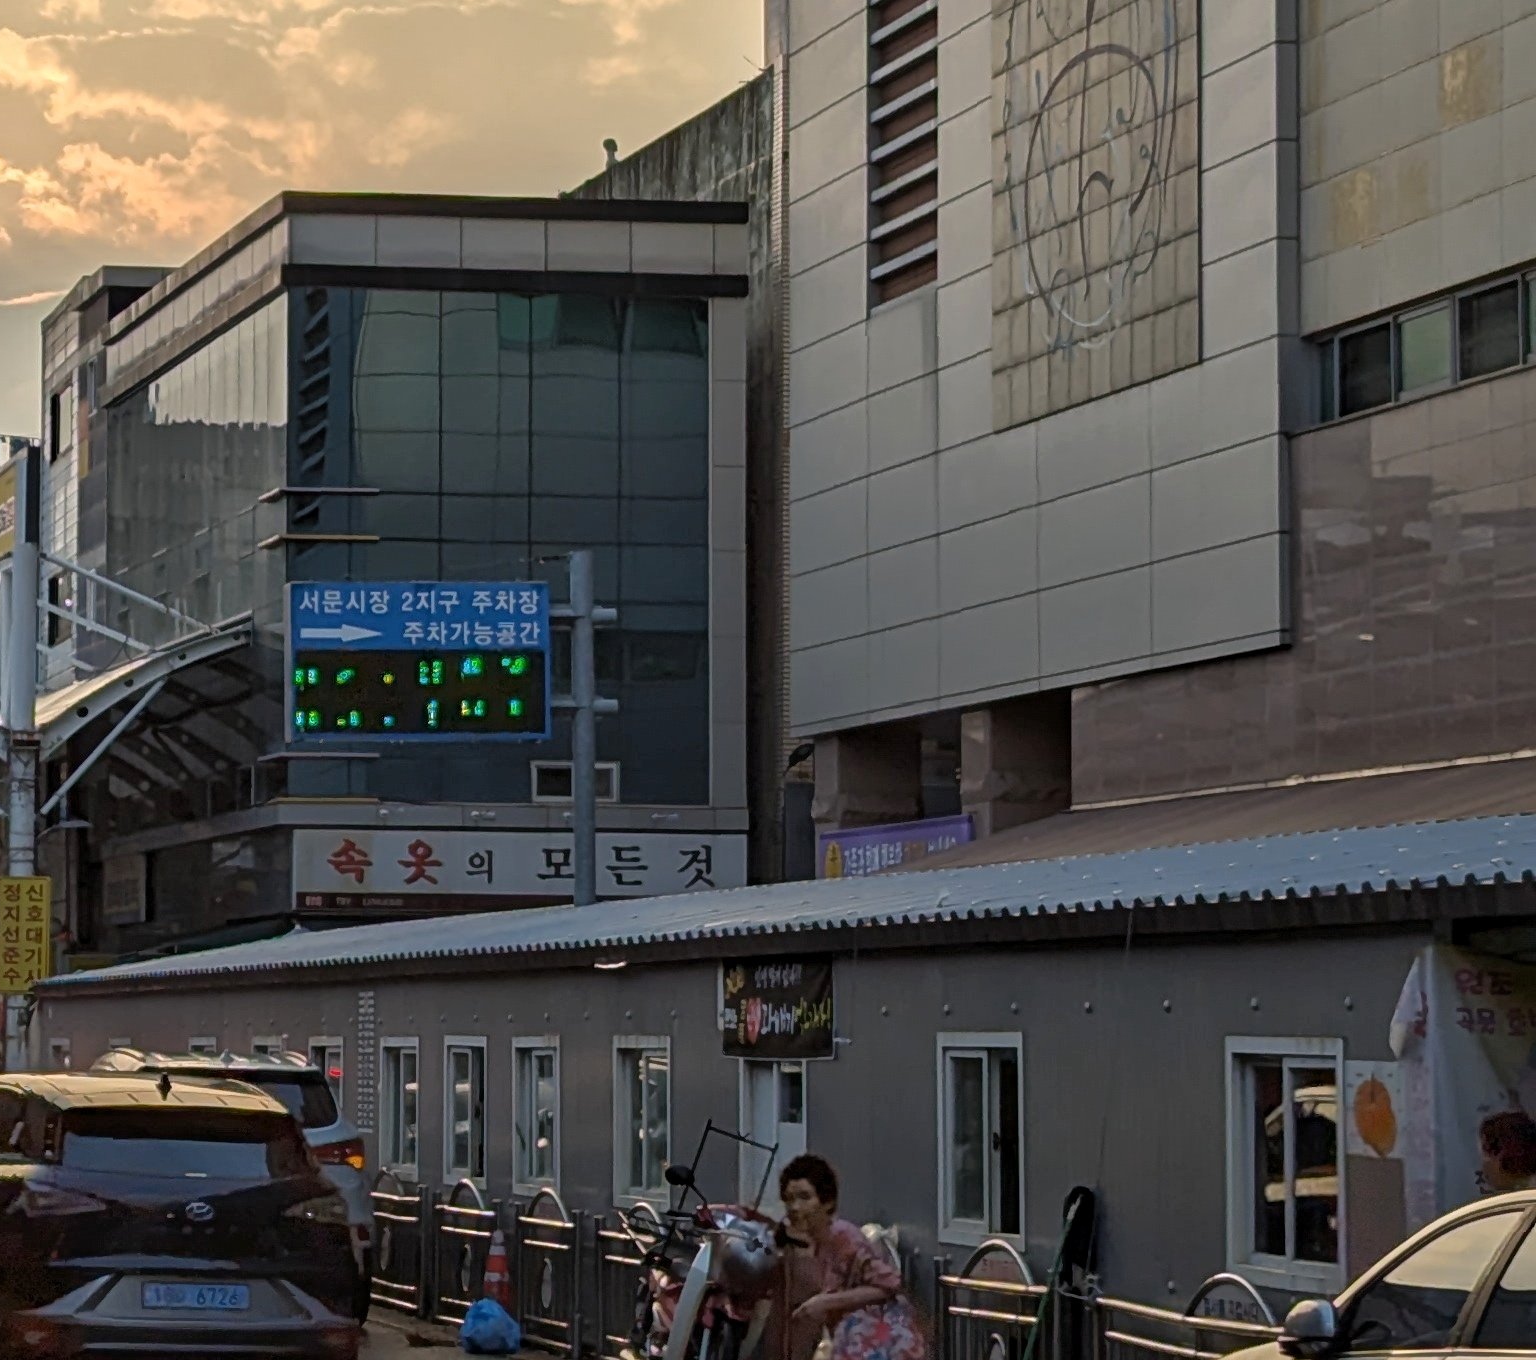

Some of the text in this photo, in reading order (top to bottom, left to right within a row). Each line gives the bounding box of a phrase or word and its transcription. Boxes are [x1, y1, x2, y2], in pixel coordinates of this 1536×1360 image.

[298, 589, 541, 615] 서문시장 2지구 주차장
[402, 620, 542, 646] 주차가능공간
[2, 884, 21, 986] 정지선준수
